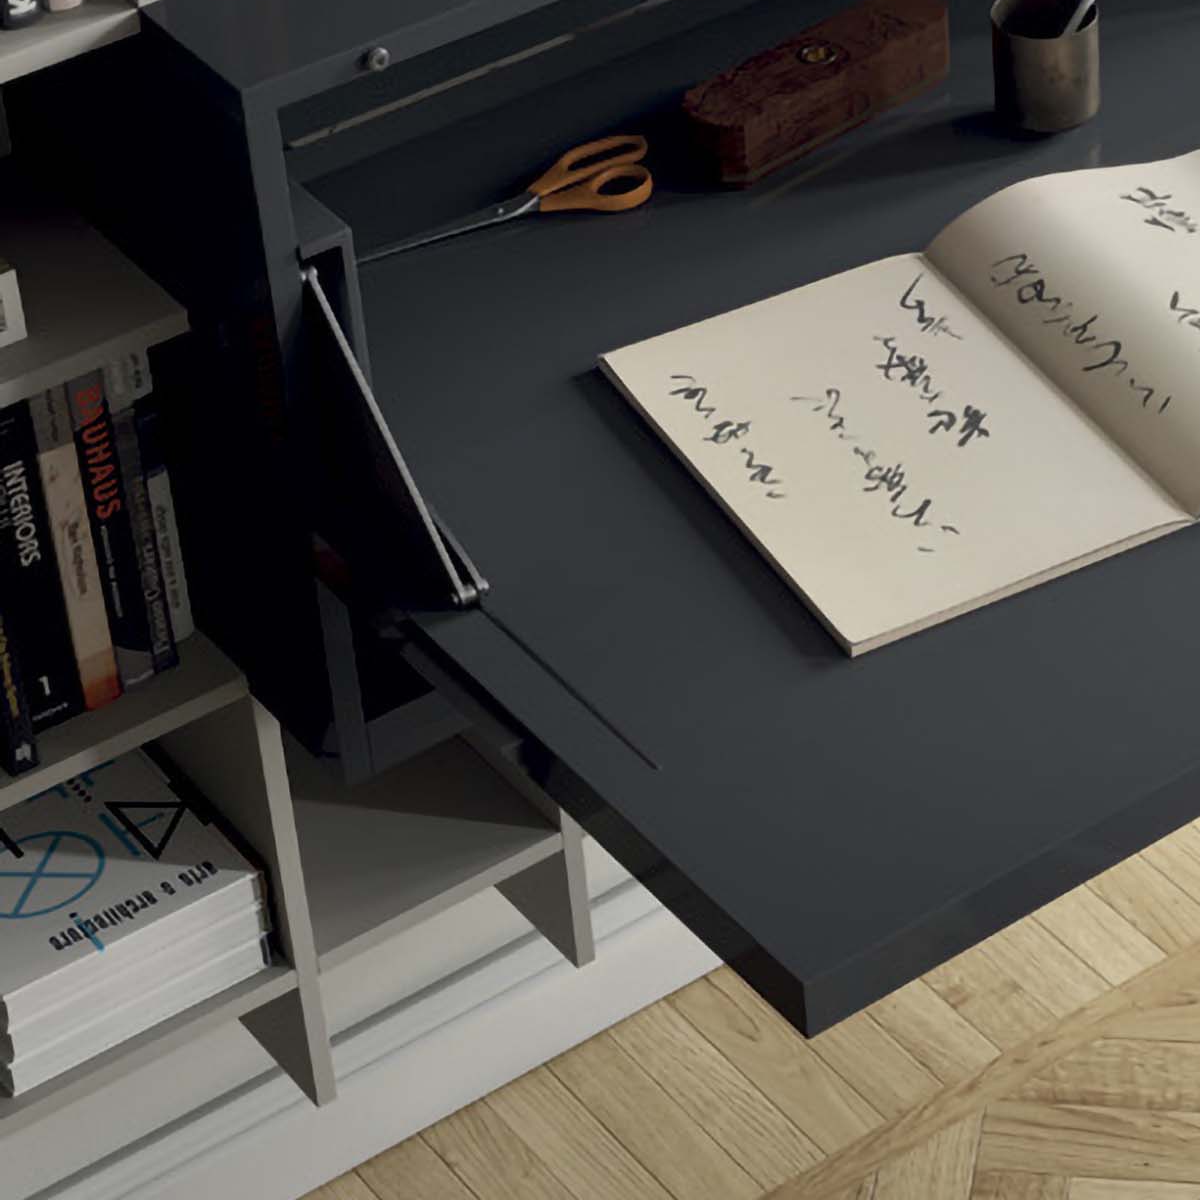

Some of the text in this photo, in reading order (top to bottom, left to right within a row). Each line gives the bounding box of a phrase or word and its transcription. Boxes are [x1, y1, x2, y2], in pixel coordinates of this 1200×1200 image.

[78, 384, 121, 520] BAUHAUS
[3, 459, 42, 568] INTERIORS
[38, 675, 51, 696] 1
[178, 861, 220, 886] arts
[48, 890, 159, 952] architecture
